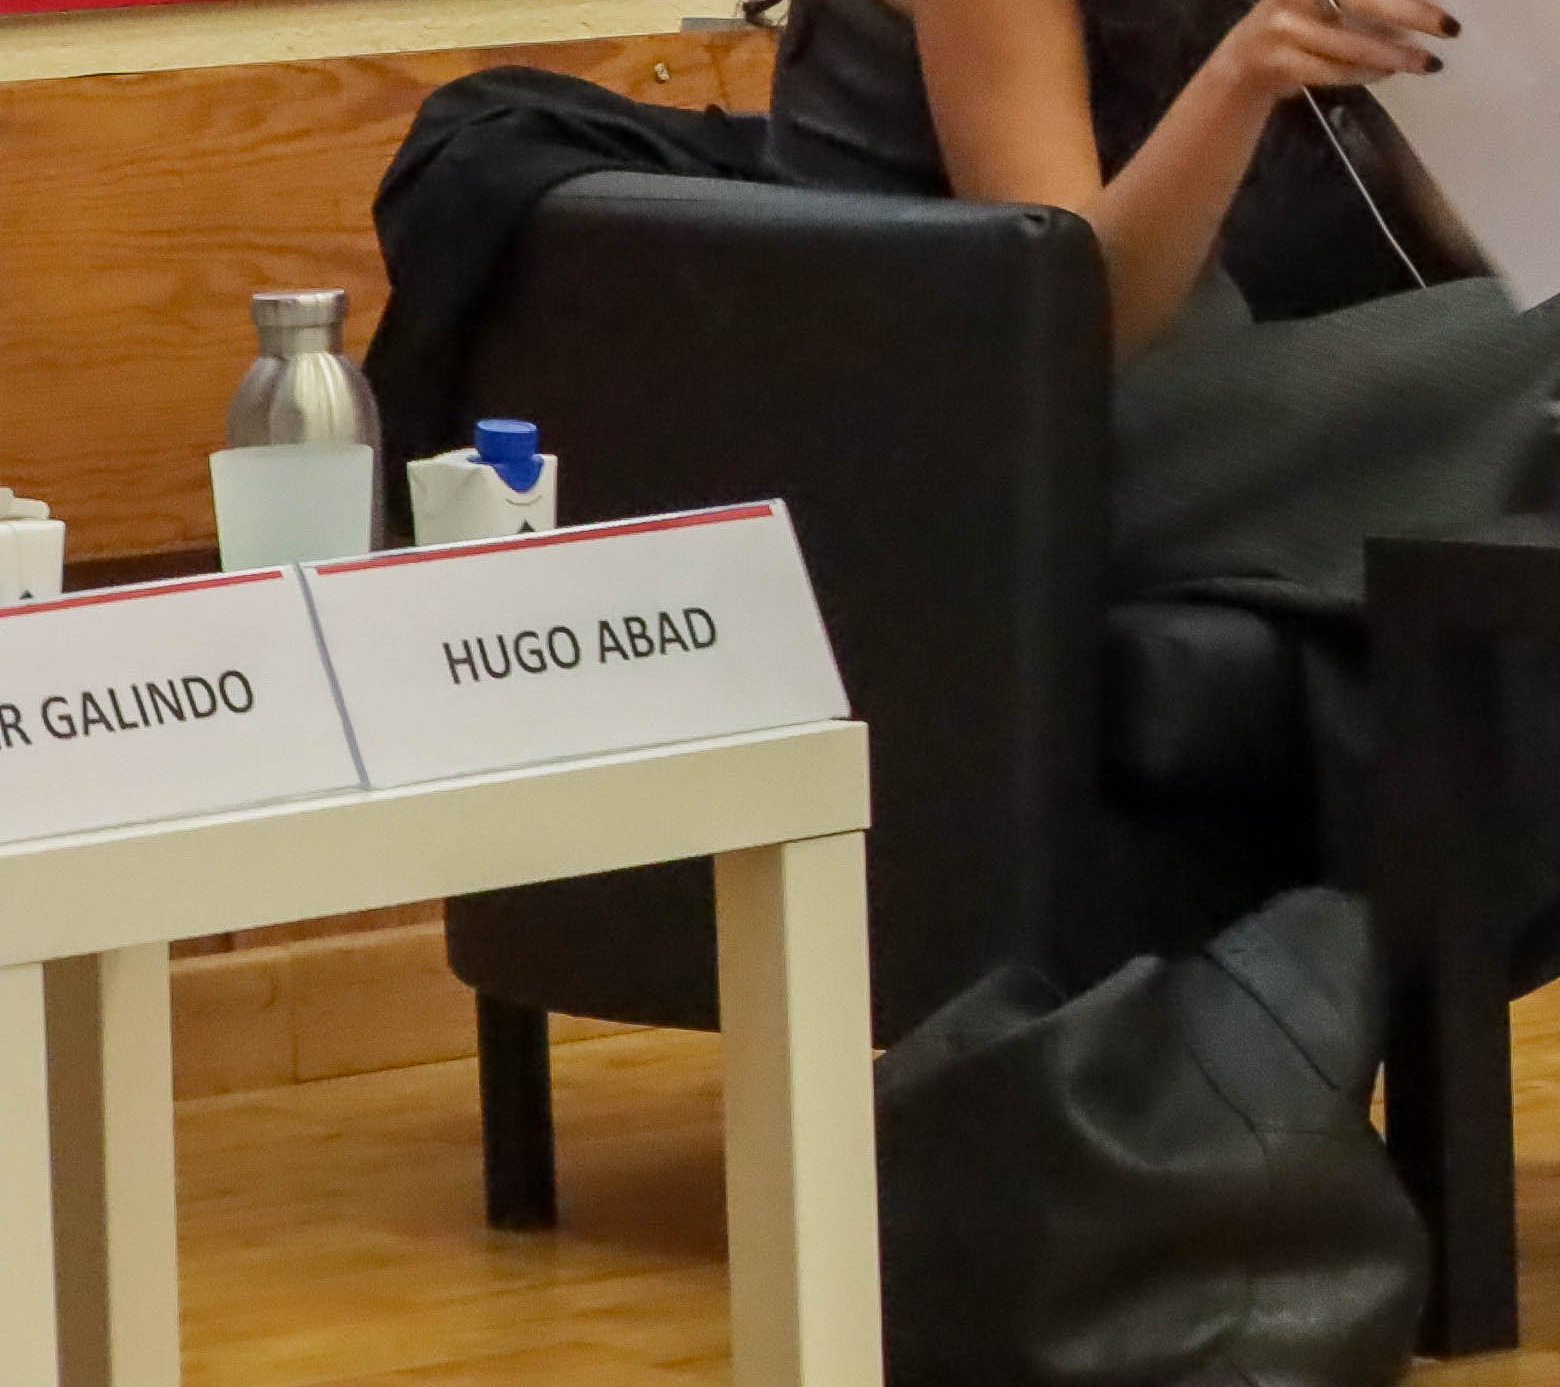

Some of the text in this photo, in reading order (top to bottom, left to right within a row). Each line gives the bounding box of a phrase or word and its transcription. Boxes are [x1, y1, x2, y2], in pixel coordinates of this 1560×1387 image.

[442, 606, 718, 685] HUGO ABAD
[41, 669, 255, 740] GALINDO
